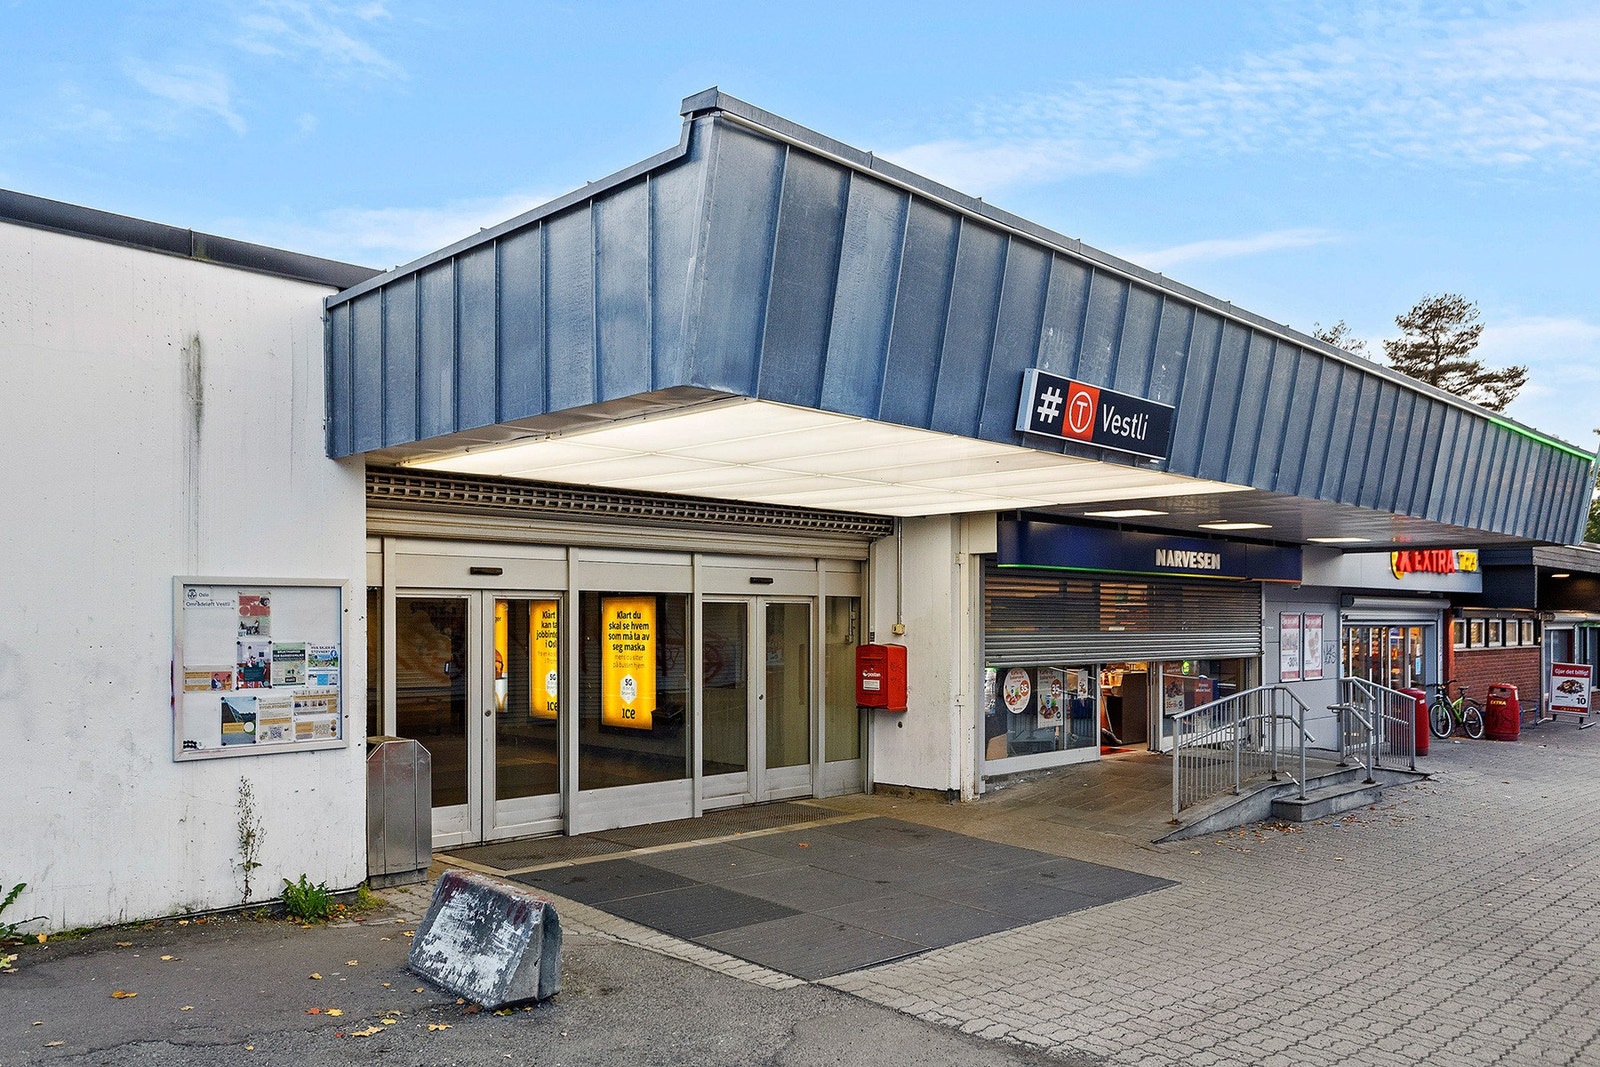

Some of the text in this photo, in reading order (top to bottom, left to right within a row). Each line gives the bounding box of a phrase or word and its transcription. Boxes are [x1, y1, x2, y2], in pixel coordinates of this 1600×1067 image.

[1103, 404, 1149, 441] Vestli
[1155, 549, 1220, 570] NARVESEN
[1415, 549, 1456, 574] EXTRA
[617, 611, 642, 619] Klart du
[541, 621, 551, 629] kan
[609, 622, 622, 630] skal
[631, 622, 649, 630] hvem
[623, 631, 633, 640] må
[613, 643, 645, 653] seg maska
[1576, 697, 1587, 705] 10
